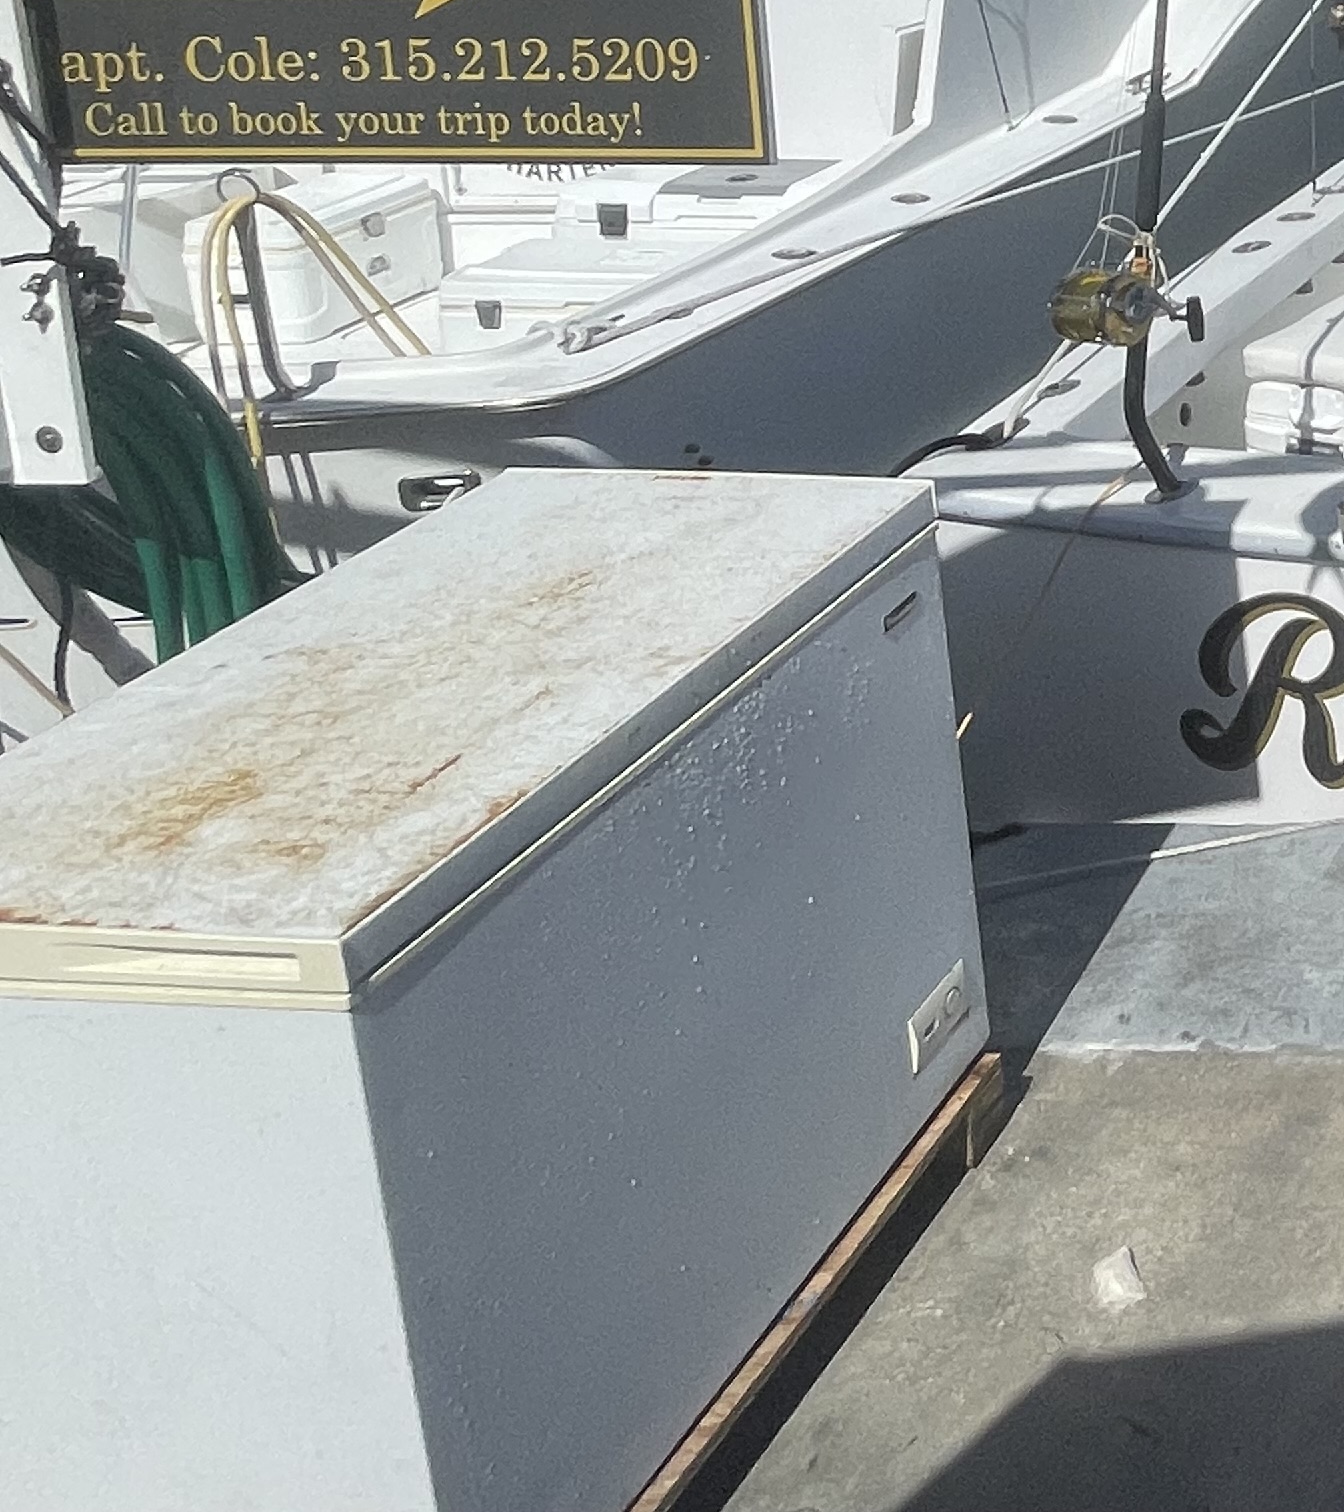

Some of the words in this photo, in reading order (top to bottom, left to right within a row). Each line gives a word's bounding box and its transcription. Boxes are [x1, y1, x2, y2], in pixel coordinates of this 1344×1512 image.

[60, 40, 165, 94] apt.
[184, 35, 321, 82] Cole:
[340, 37, 700, 82] 315.212.5209
[84, 101, 168, 137] Call
[179, 104, 219, 136] to
[229, 101, 323, 137] book
[334, 109, 424, 144] your
[436, 102, 512, 143] trip
[522, 101, 643, 144] today!
